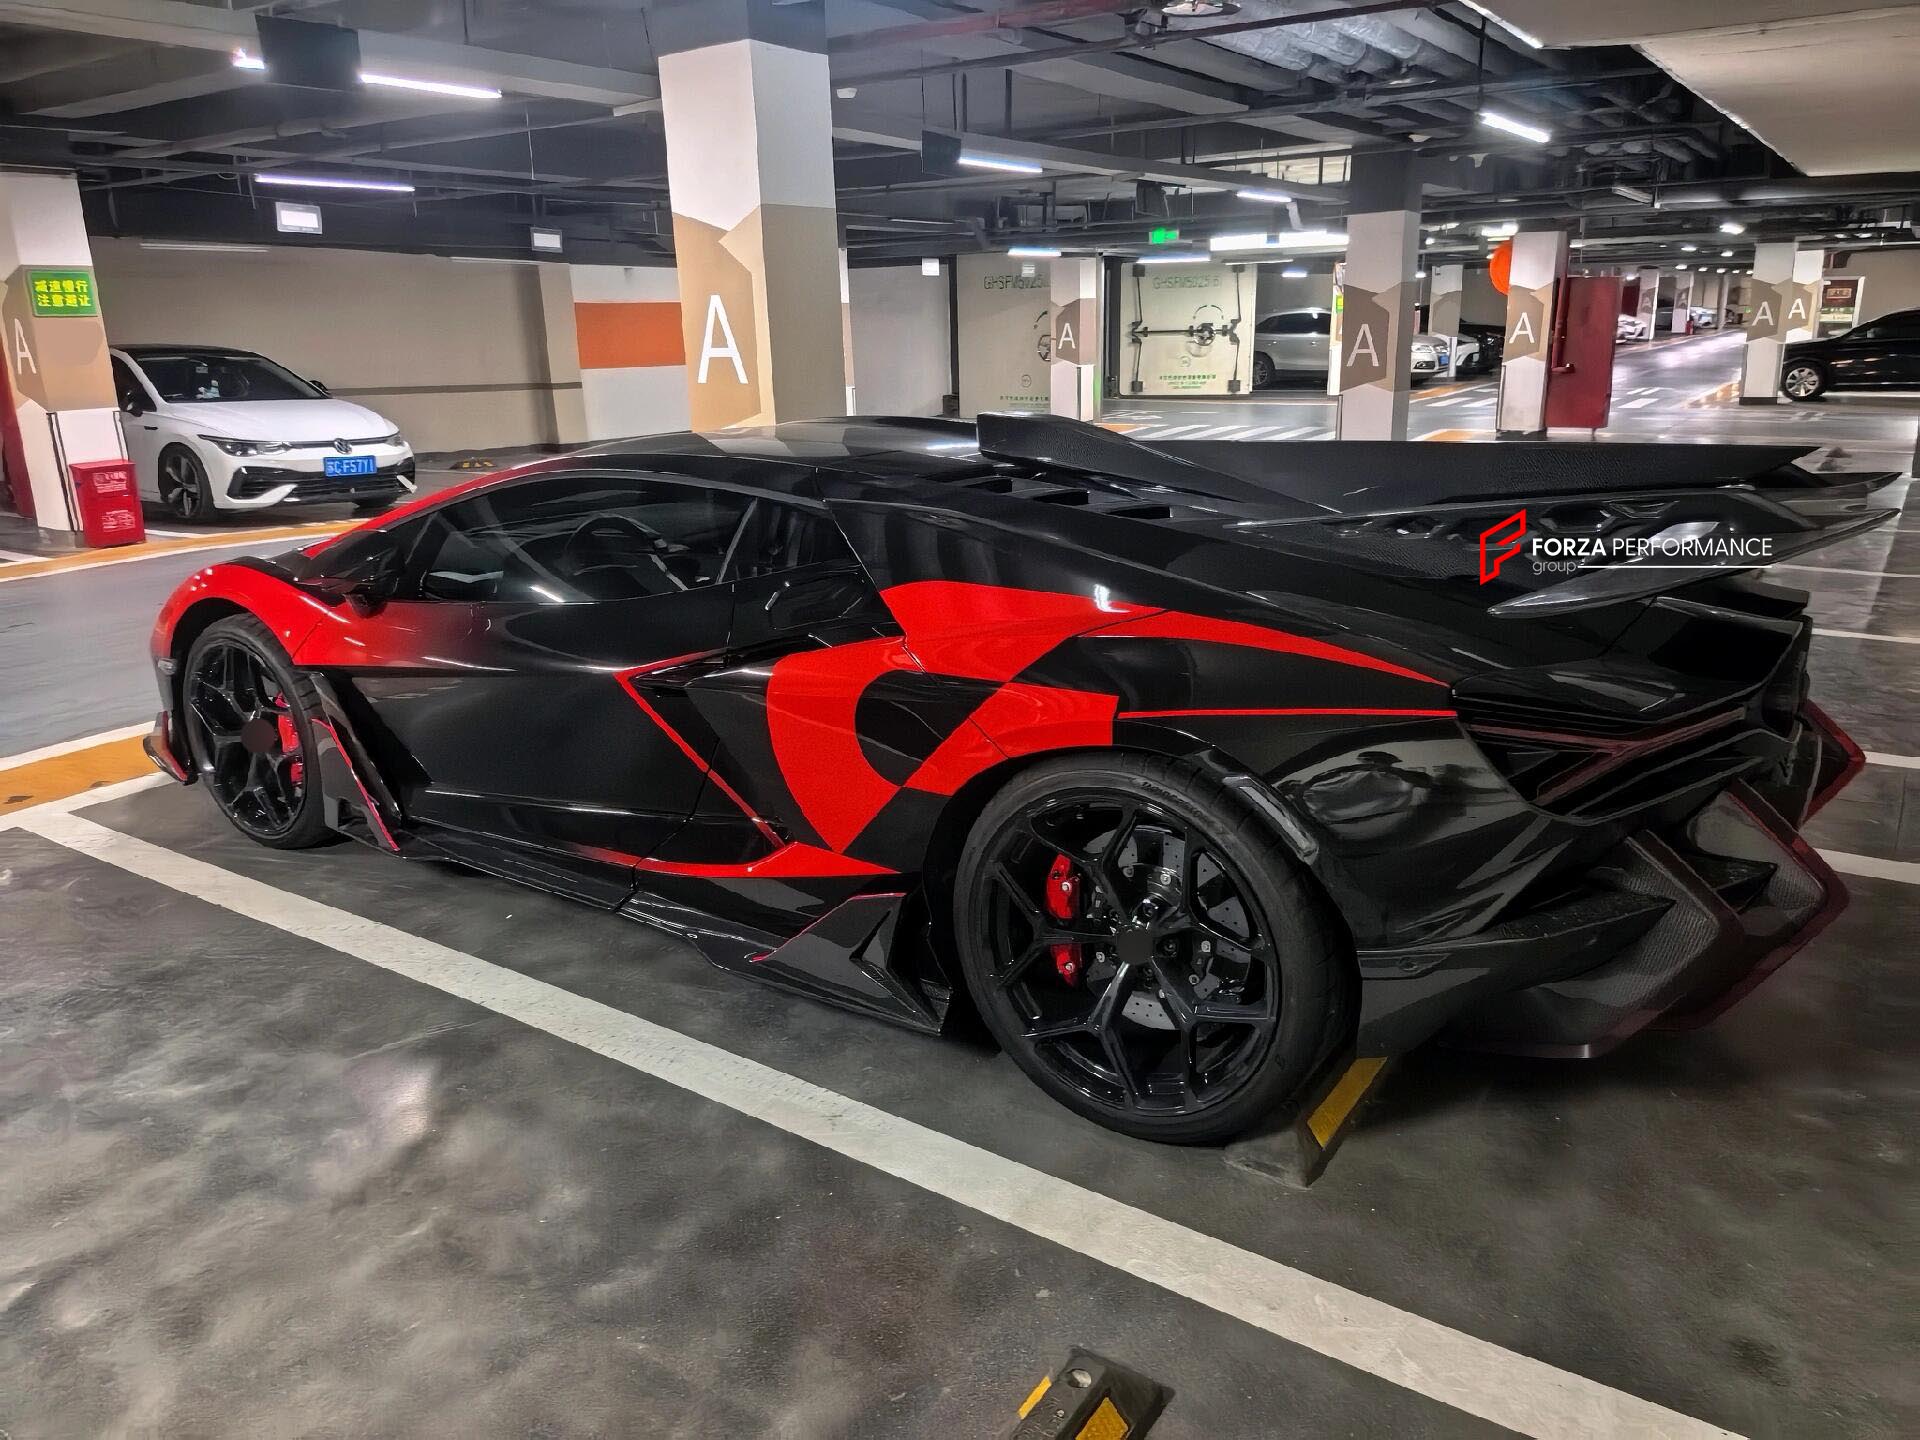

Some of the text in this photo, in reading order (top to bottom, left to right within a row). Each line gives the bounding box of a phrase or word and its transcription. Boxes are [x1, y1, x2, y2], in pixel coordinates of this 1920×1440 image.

[1752, 301, 1774, 326] A
[1788, 298, 1806, 319] A
[697, 294, 748, 384] A
[1057, 322, 1076, 349] A
[1509, 312, 1535, 344] A
[14, 318, 37, 375] A
[1346, 323, 1379, 366] A
